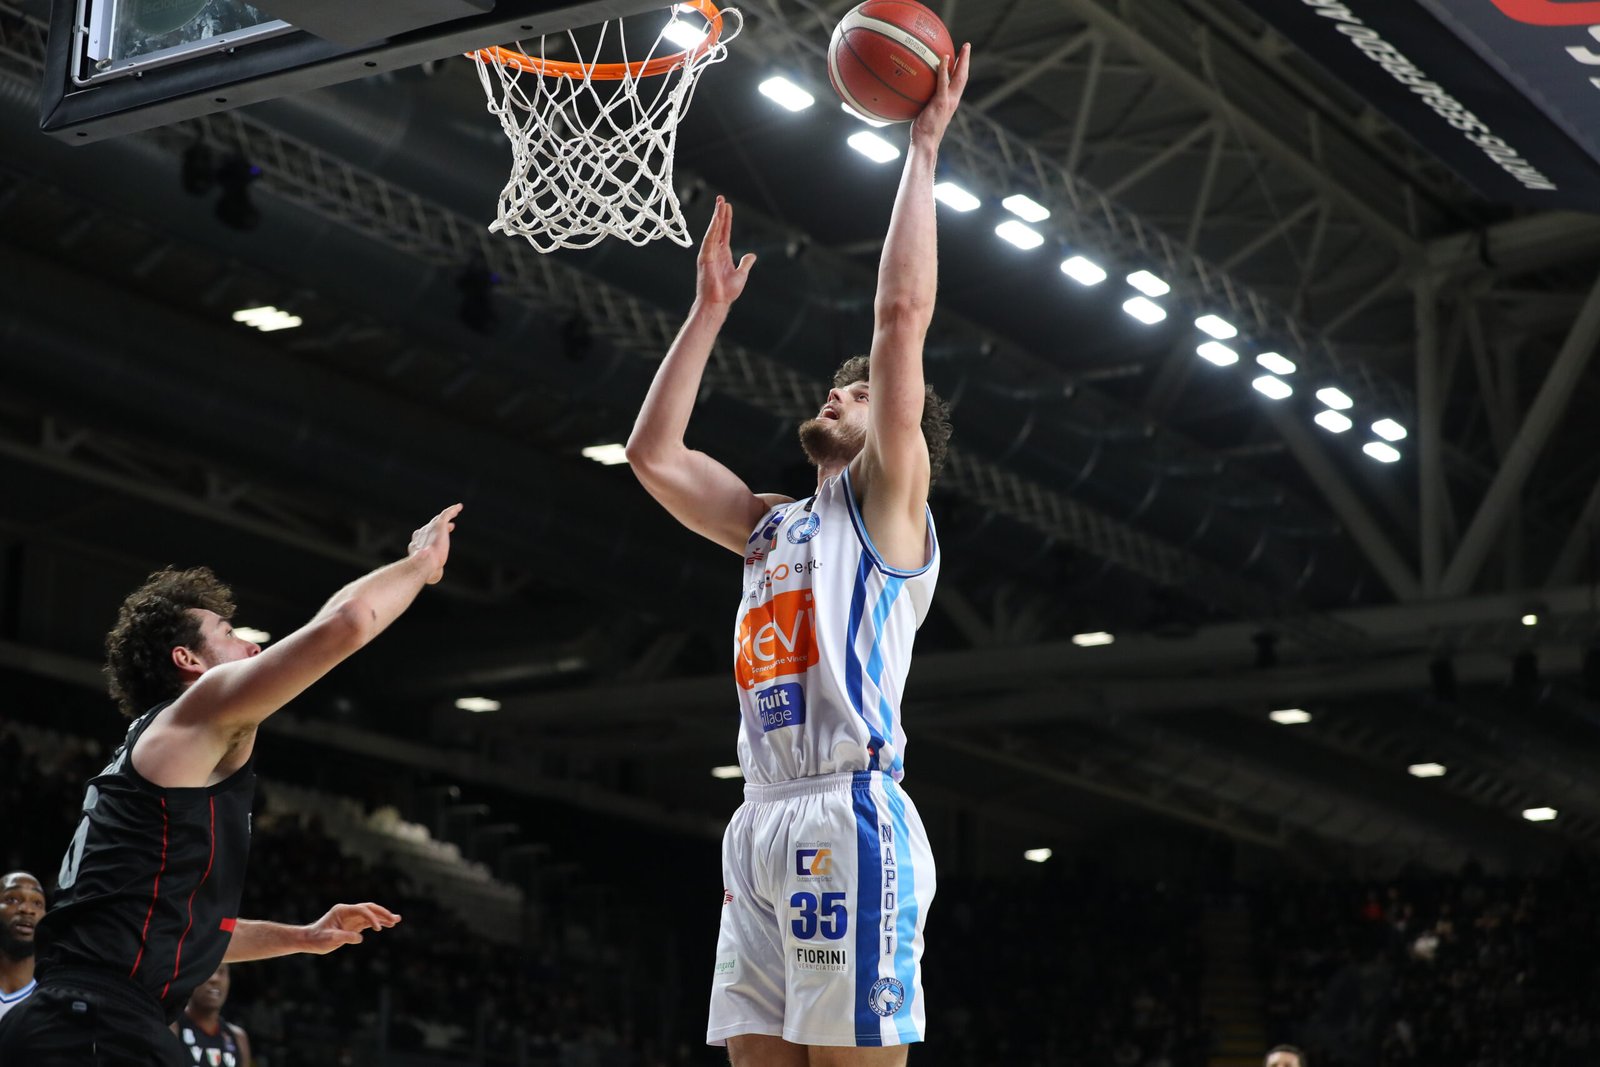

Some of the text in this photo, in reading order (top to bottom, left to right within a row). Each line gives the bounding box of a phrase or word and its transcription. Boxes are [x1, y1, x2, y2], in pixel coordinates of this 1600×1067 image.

[756, 688, 790, 712] fruit
[760, 708, 793, 727] illage
[881, 823, 896, 955] NAPOLI
[790, 891, 848, 940] 35
[797, 948, 846, 965] FIORINI
